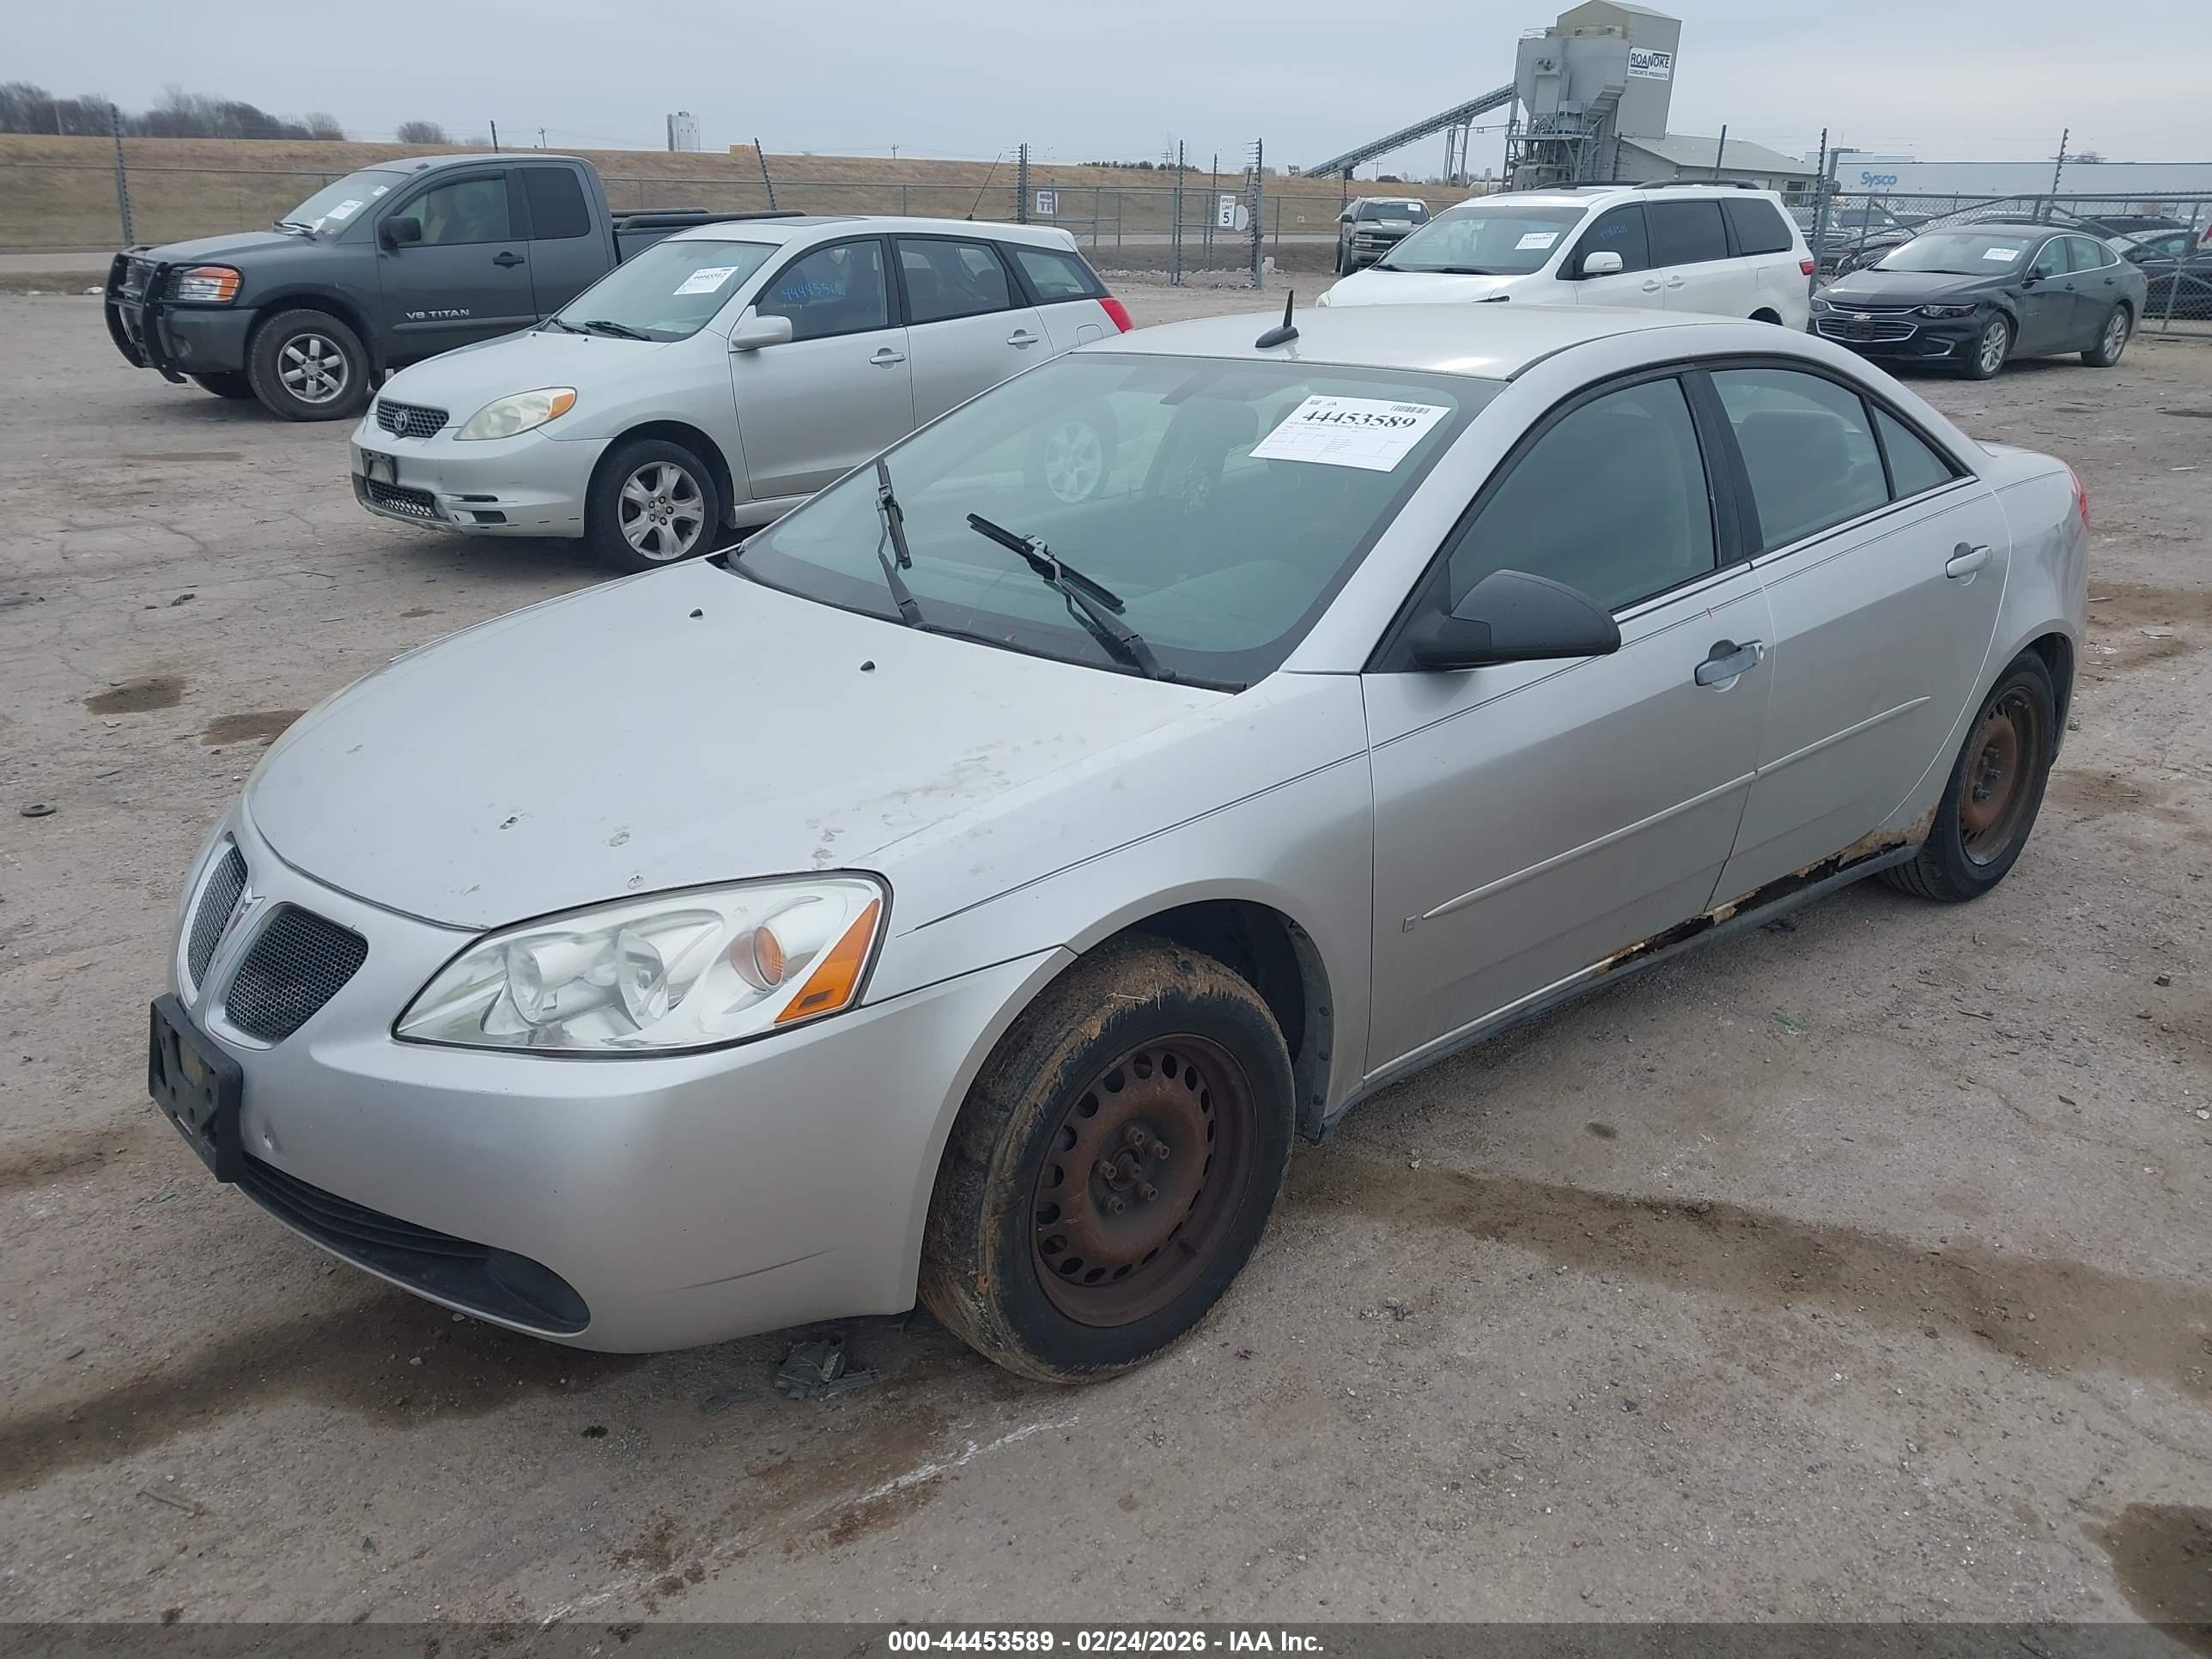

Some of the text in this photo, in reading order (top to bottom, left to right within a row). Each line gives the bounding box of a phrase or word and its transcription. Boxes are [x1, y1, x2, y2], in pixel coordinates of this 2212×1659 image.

[1631, 52, 1670, 69] ROANOKE
[1861, 171, 1898, 188] Sysco
[1223, 211, 1230, 224] 5
[405, 308, 470, 319] V8 TITAN
[1302, 410, 1417, 429] 44453589
